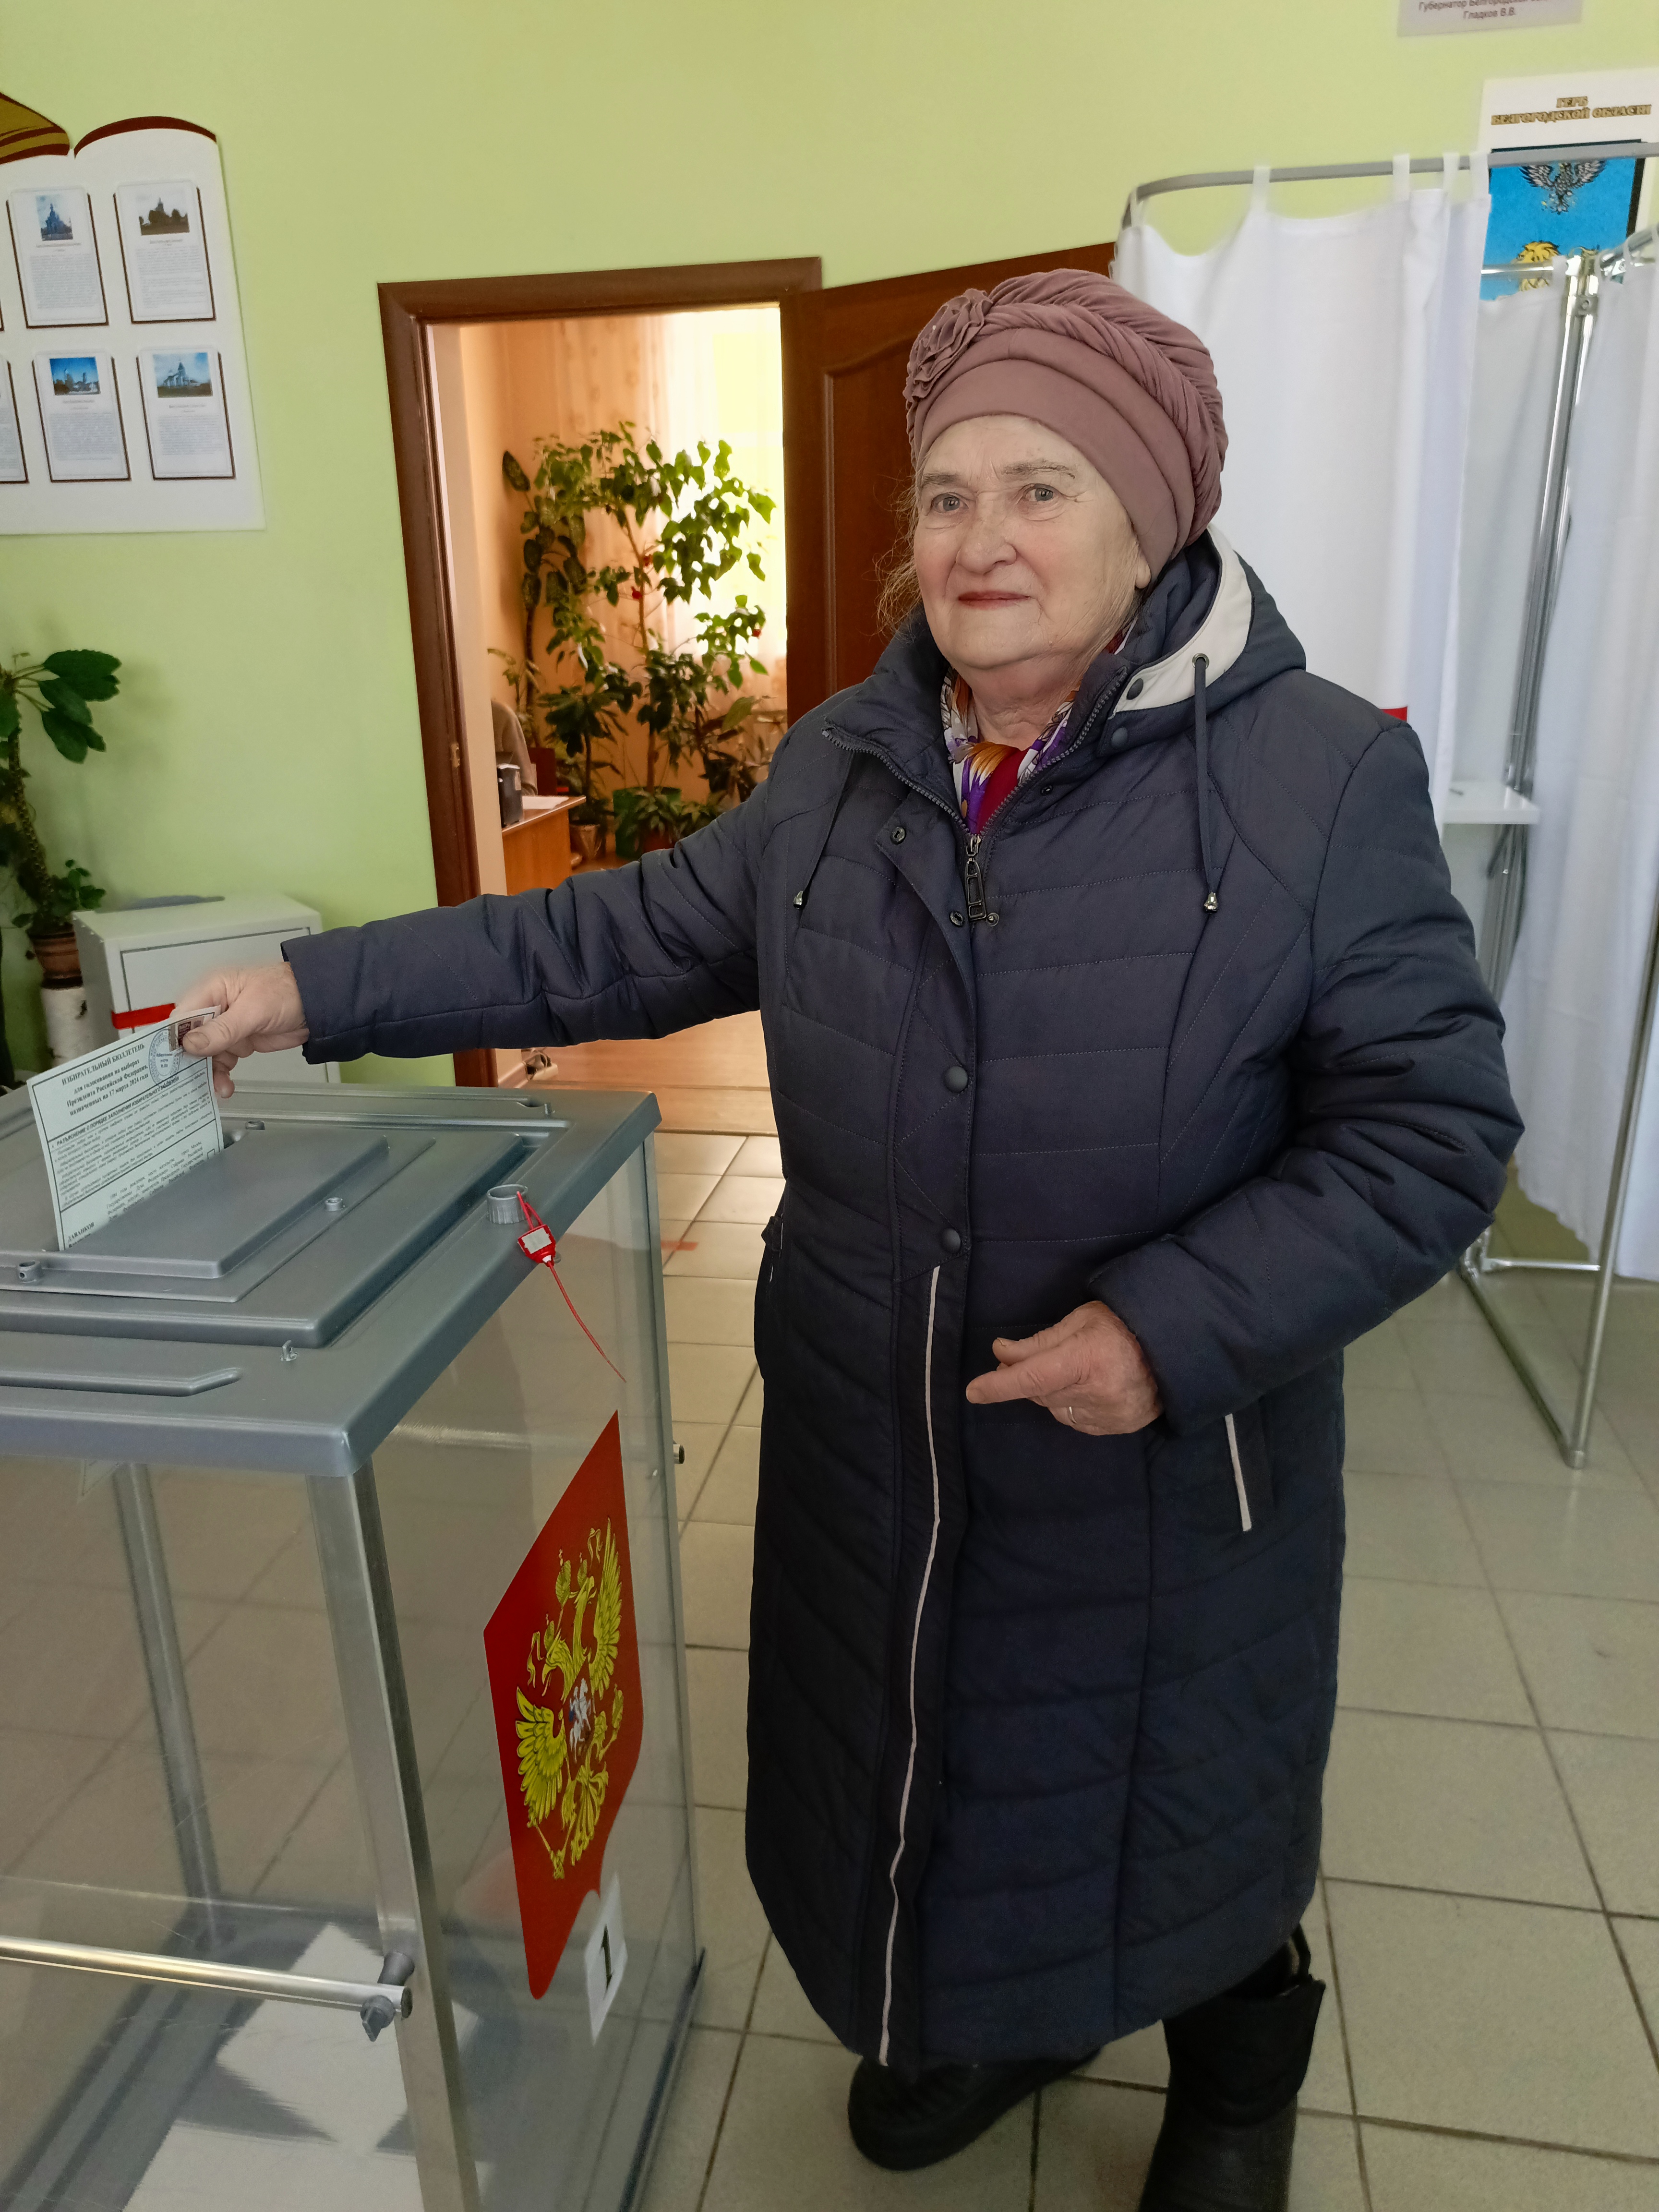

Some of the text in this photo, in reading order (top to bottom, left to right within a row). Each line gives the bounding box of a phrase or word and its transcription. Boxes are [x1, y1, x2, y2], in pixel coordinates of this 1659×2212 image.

[1491, 104, 1652, 125] БЕЛГОРОДСКОЙ ОБЛАСТИ
[1556, 96, 1588, 108] ГЕРБ
[62, 1057, 111, 1085] ИЗБИРАТЕЛЬНЫЙ
[112, 1043, 144, 1062] БЮЛЛЕТЕНЬ
[74, 1086, 83, 1094] для
[84, 1072, 114, 1089] голосования
[121, 1059, 140, 1071] выборах
[67, 1090, 96, 1107] Президента
[96, 1076, 123, 1093] Российской
[70, 1098, 102, 1116] назначенных
[115, 1084, 129, 1095] марта
[130, 1077, 139, 1086] 2024
[140, 1073, 149, 1082] года
